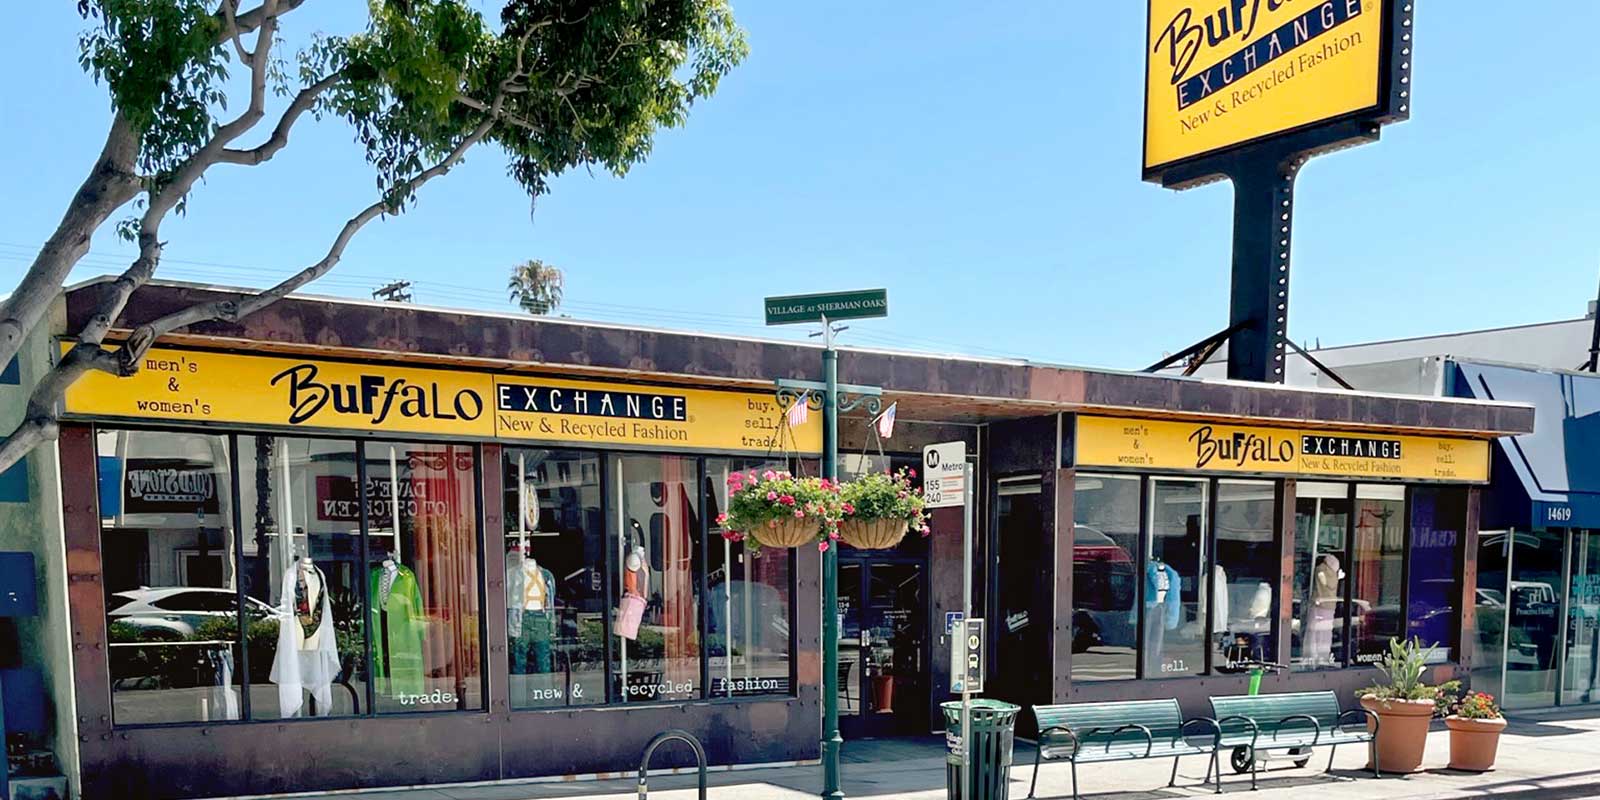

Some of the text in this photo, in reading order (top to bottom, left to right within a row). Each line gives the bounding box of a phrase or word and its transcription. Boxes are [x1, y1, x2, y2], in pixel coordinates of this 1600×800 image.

[1178, 0, 1360, 108] EXCHANGE
[1180, 32, 1362, 135] New & Recycled Fashion
[767, 304, 805, 315] VILLAGE
[817, 300, 861, 312] SHERMAN
[862, 299, 886, 308] OAKS
[145, 357, 198, 373] men's
[168, 376, 180, 391] &
[137, 399, 211, 415] women's
[499, 385, 685, 421] EXCHANGE
[747, 398, 775, 413] buy.
[499, 415, 688, 441] New & Recycled Fashion
[744, 417, 779, 429] sell.
[1123, 426, 1149, 436] men's
[1132, 440, 1139, 450] &
[1302, 436, 1400, 459] EXCHANGE
[941, 462, 963, 472] Metro
[1118, 454, 1154, 465] women's
[1301, 458, 1400, 473] New & Recycled Fashion
[926, 480, 940, 491] 155
[926, 493, 941, 503] 240
[1548, 507, 1571, 520] 14619
[1161, 660, 1189, 672] sell.
[533, 676, 779, 700] new & recycled fashion
[399, 688, 460, 705] trade.
